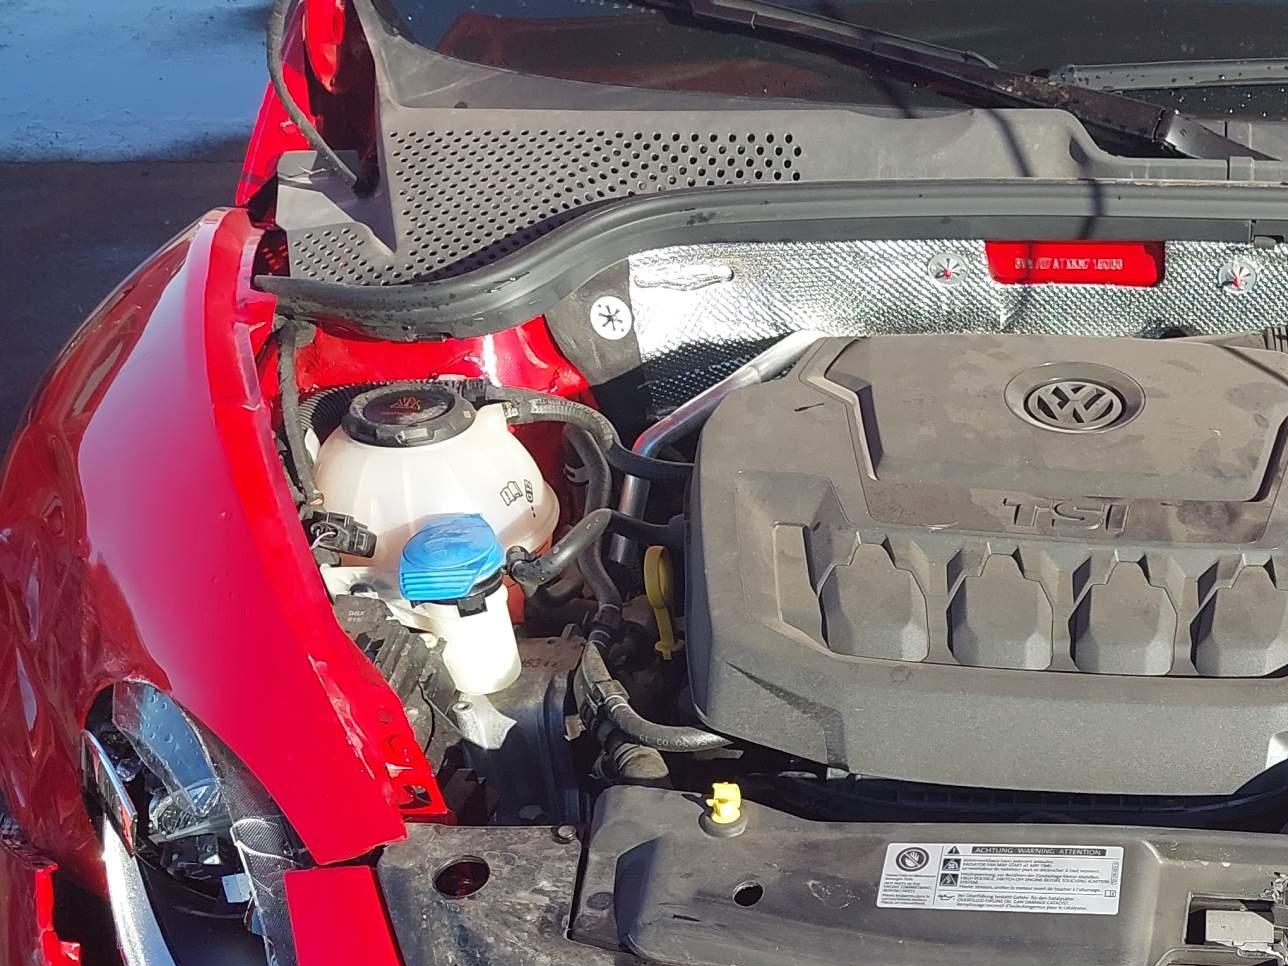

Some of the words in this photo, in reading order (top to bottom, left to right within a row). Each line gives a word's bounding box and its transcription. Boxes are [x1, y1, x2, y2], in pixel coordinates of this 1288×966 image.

[1003, 498, 1129, 533] TSI
[1018, 847, 1056, 855] WARNING
[1059, 848, 1101, 856] ATTENTION
